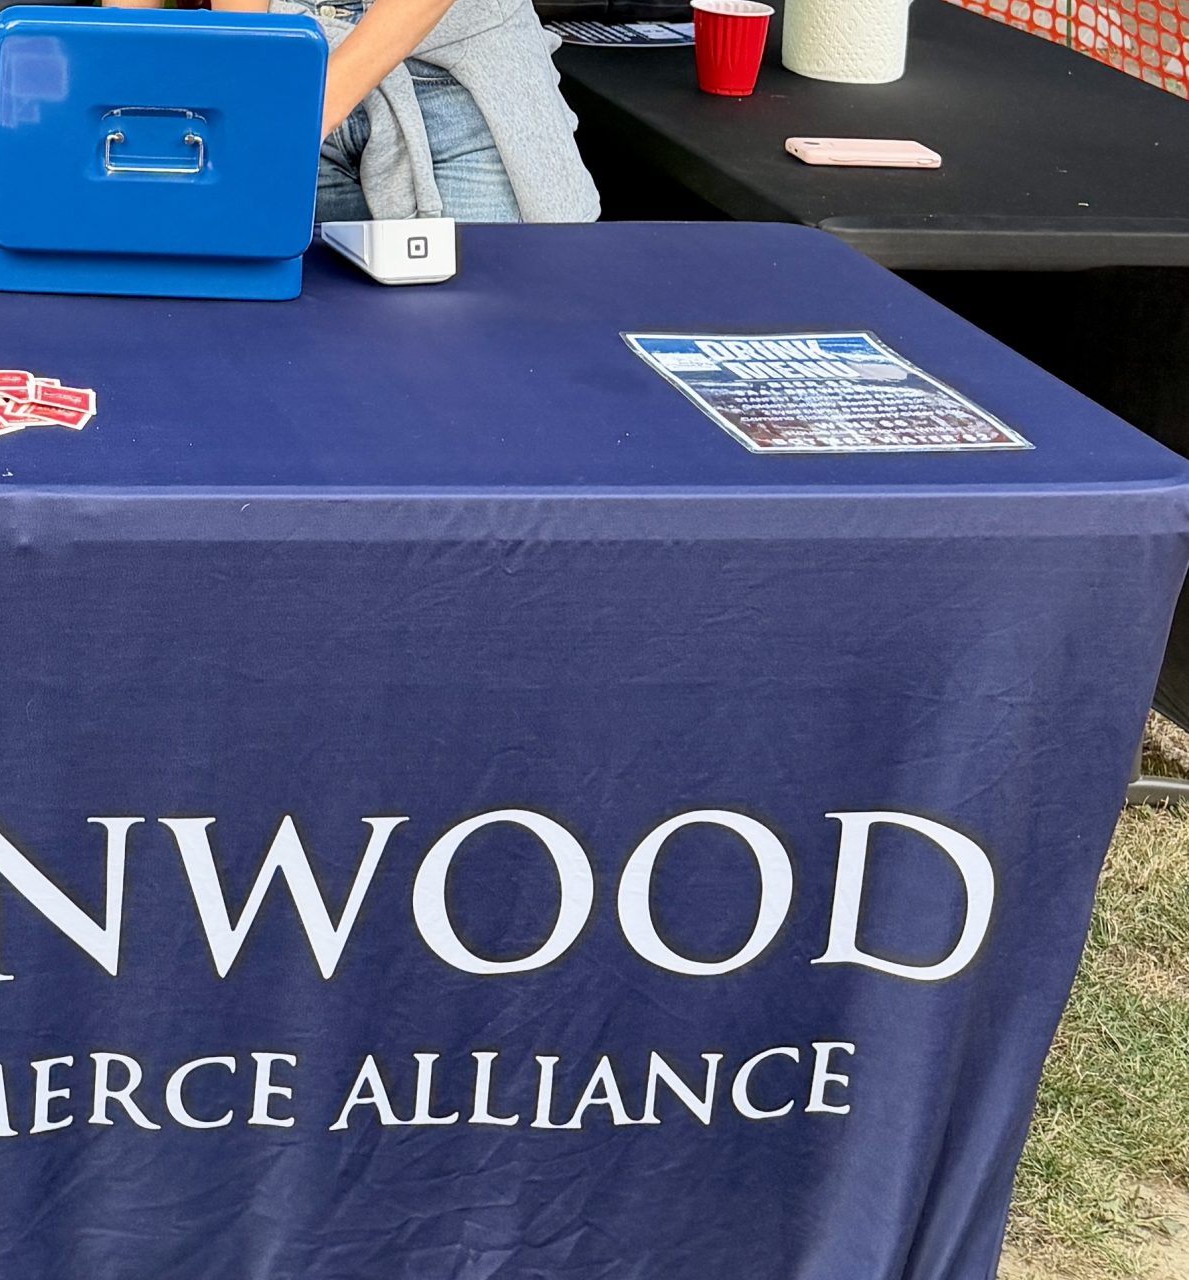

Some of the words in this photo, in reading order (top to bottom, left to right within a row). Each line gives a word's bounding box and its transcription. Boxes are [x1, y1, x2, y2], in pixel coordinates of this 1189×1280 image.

[694, 340, 841, 361] DRINK
[721, 360, 861, 379] MENU
[330, 1039, 856, 1130] ALLIANCE
